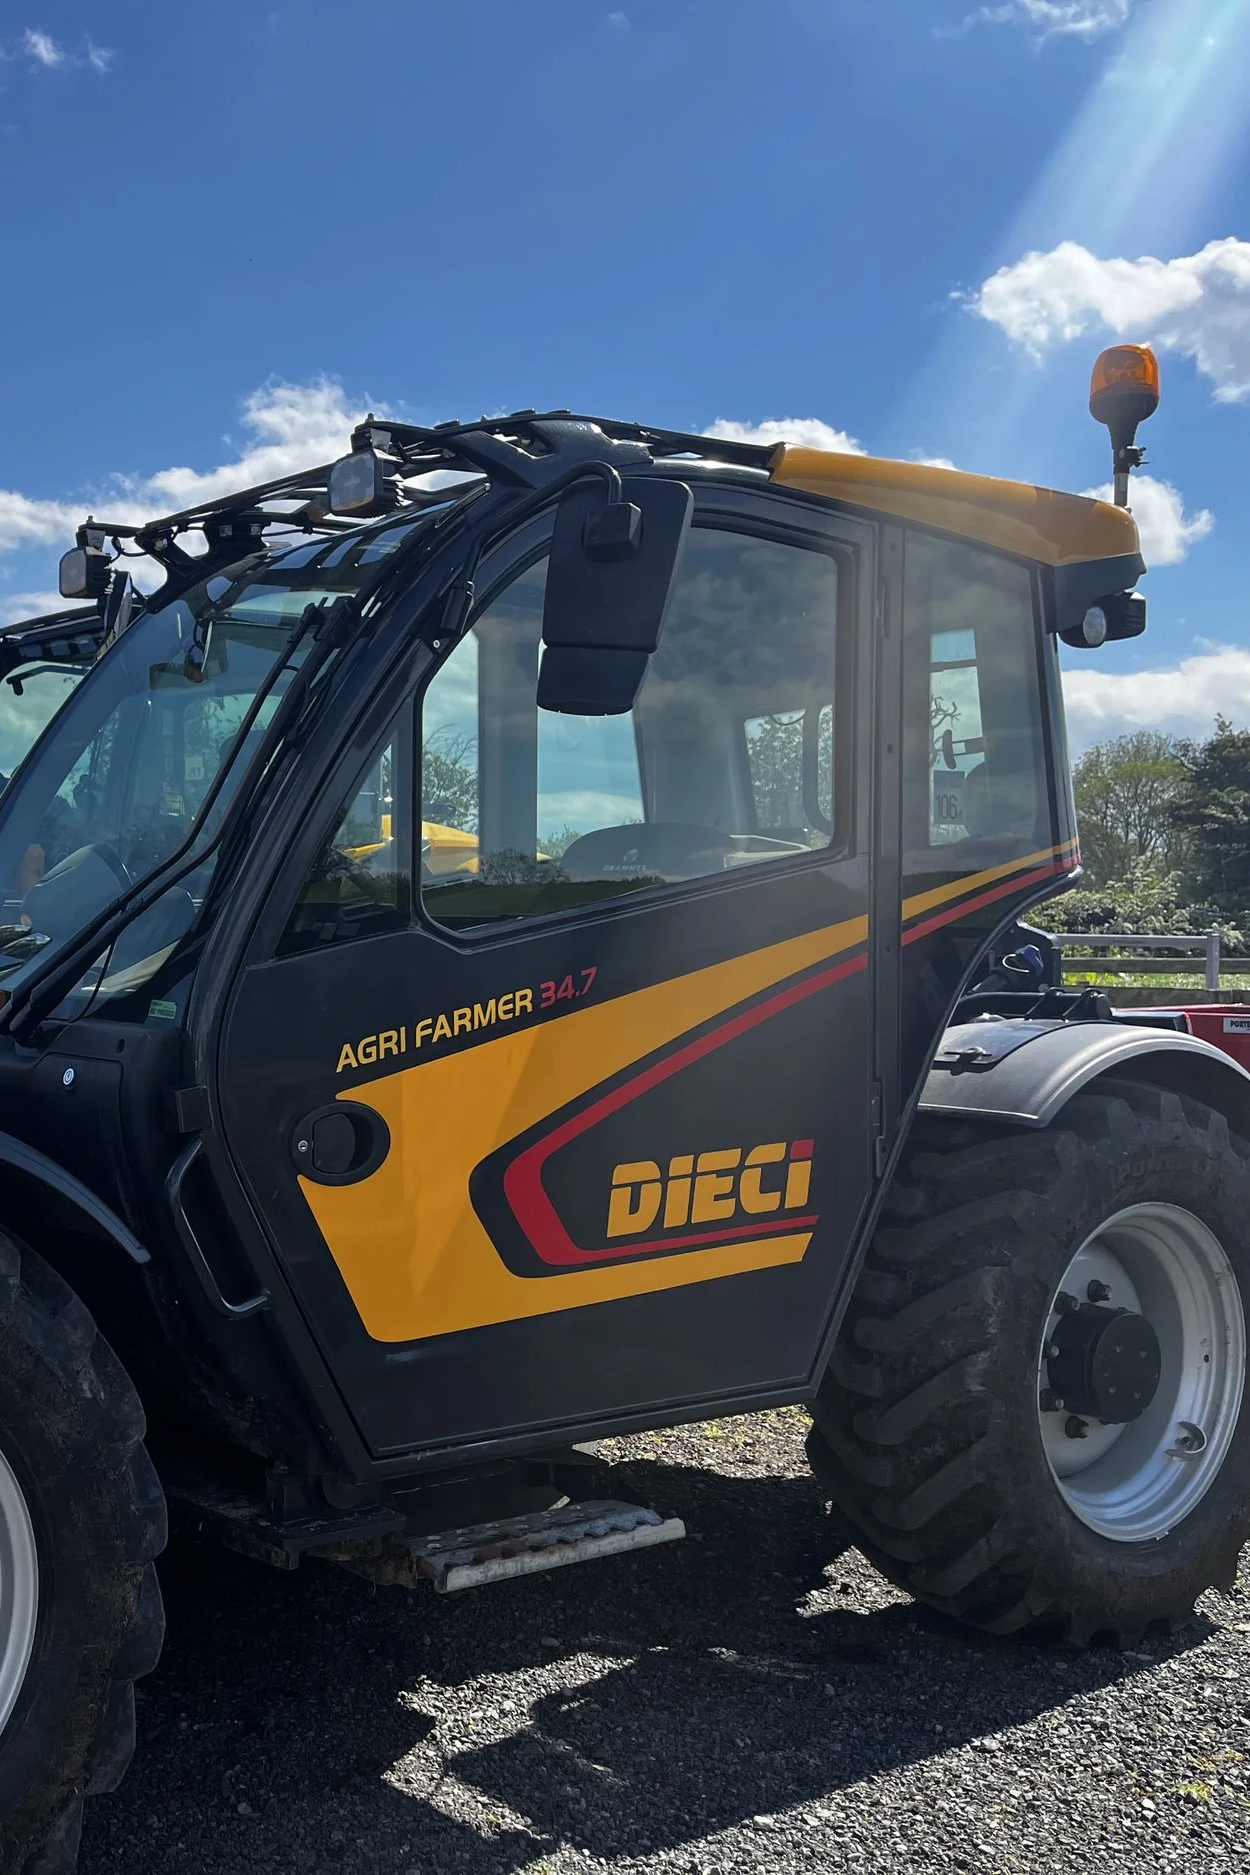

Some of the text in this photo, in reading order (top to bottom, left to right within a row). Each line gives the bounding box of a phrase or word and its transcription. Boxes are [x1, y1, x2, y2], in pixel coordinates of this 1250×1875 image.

[935, 794, 958, 820] 106
[335, 966, 598, 1073] AGRI FARMER 34.7
[606, 1138, 815, 1239] DIECI
